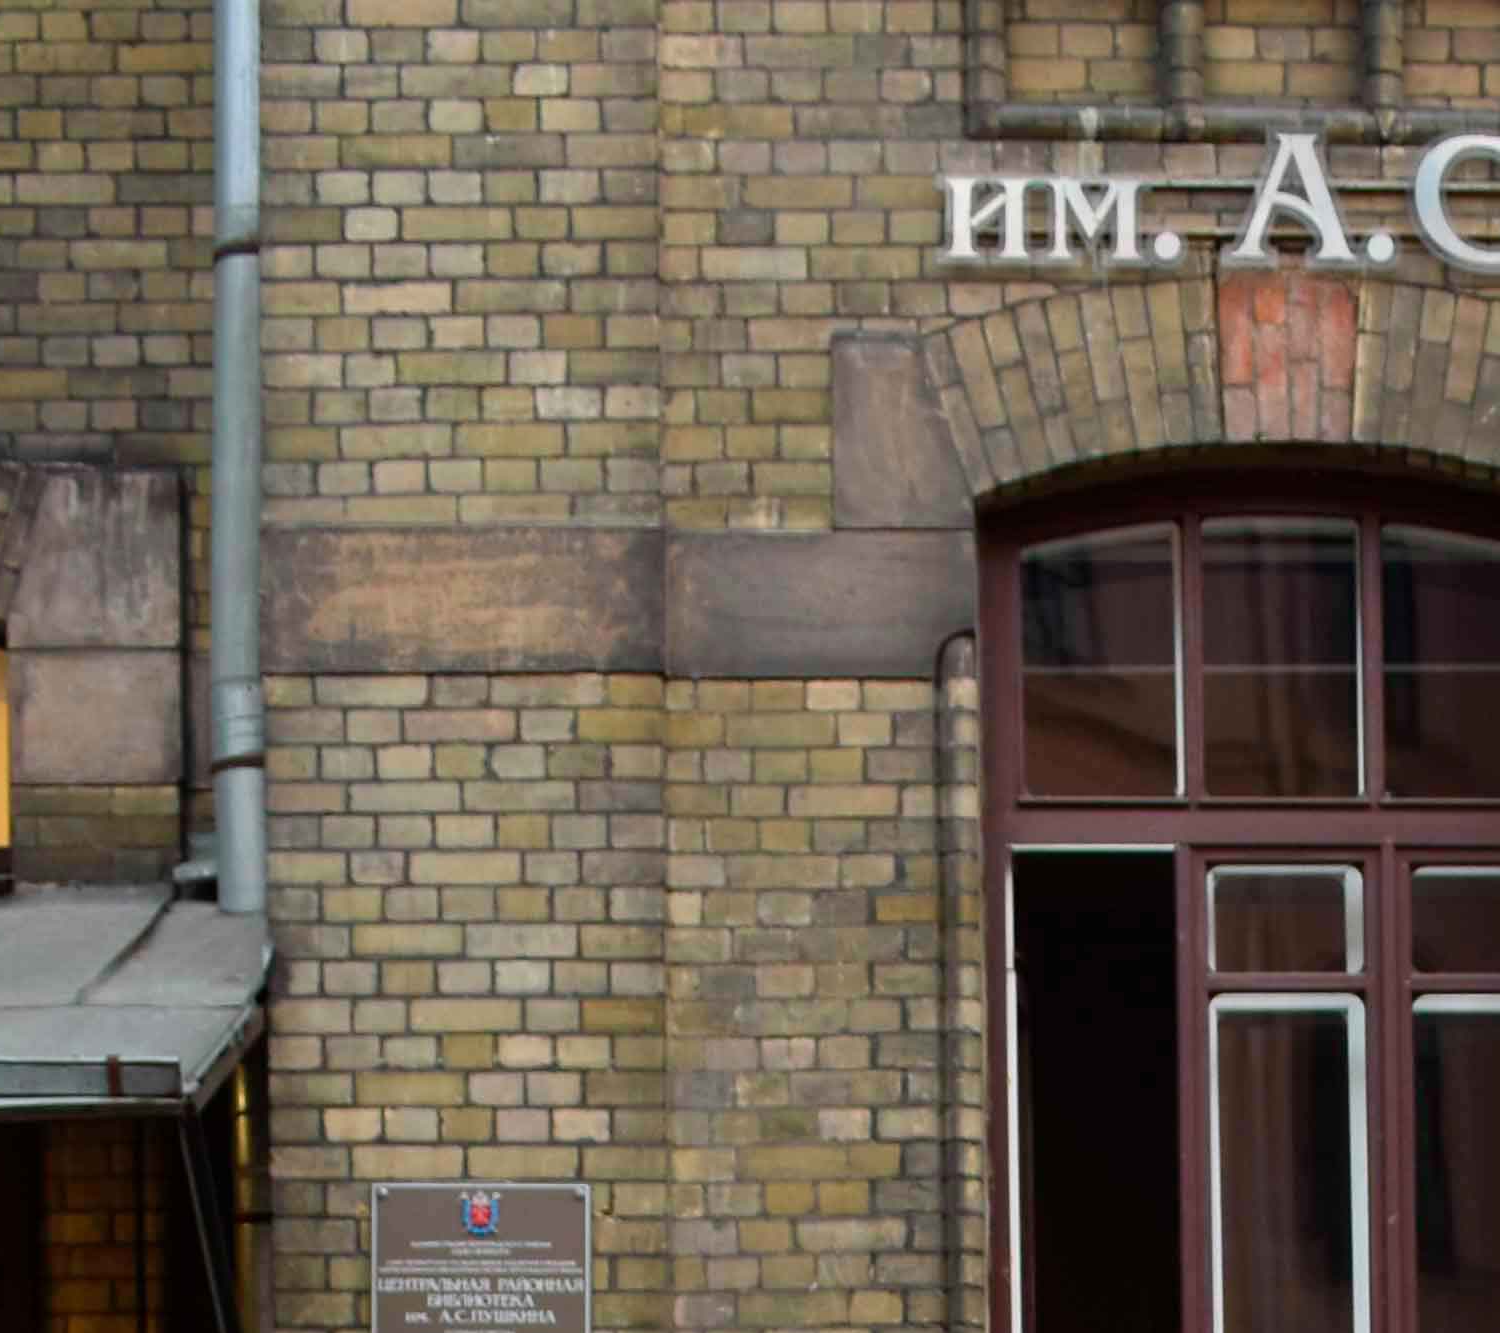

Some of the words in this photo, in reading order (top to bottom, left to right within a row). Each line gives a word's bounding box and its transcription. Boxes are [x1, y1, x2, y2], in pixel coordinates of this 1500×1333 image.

[944, 176, 1182, 264] им.
[377, 1277, 492, 1294] ЦЕНТРАЛЬНАЯ
[497, 1275, 584, 1292] РАЙОННАЯ
[426, 1293, 535, 1308] БИБЛИОТЕКА
